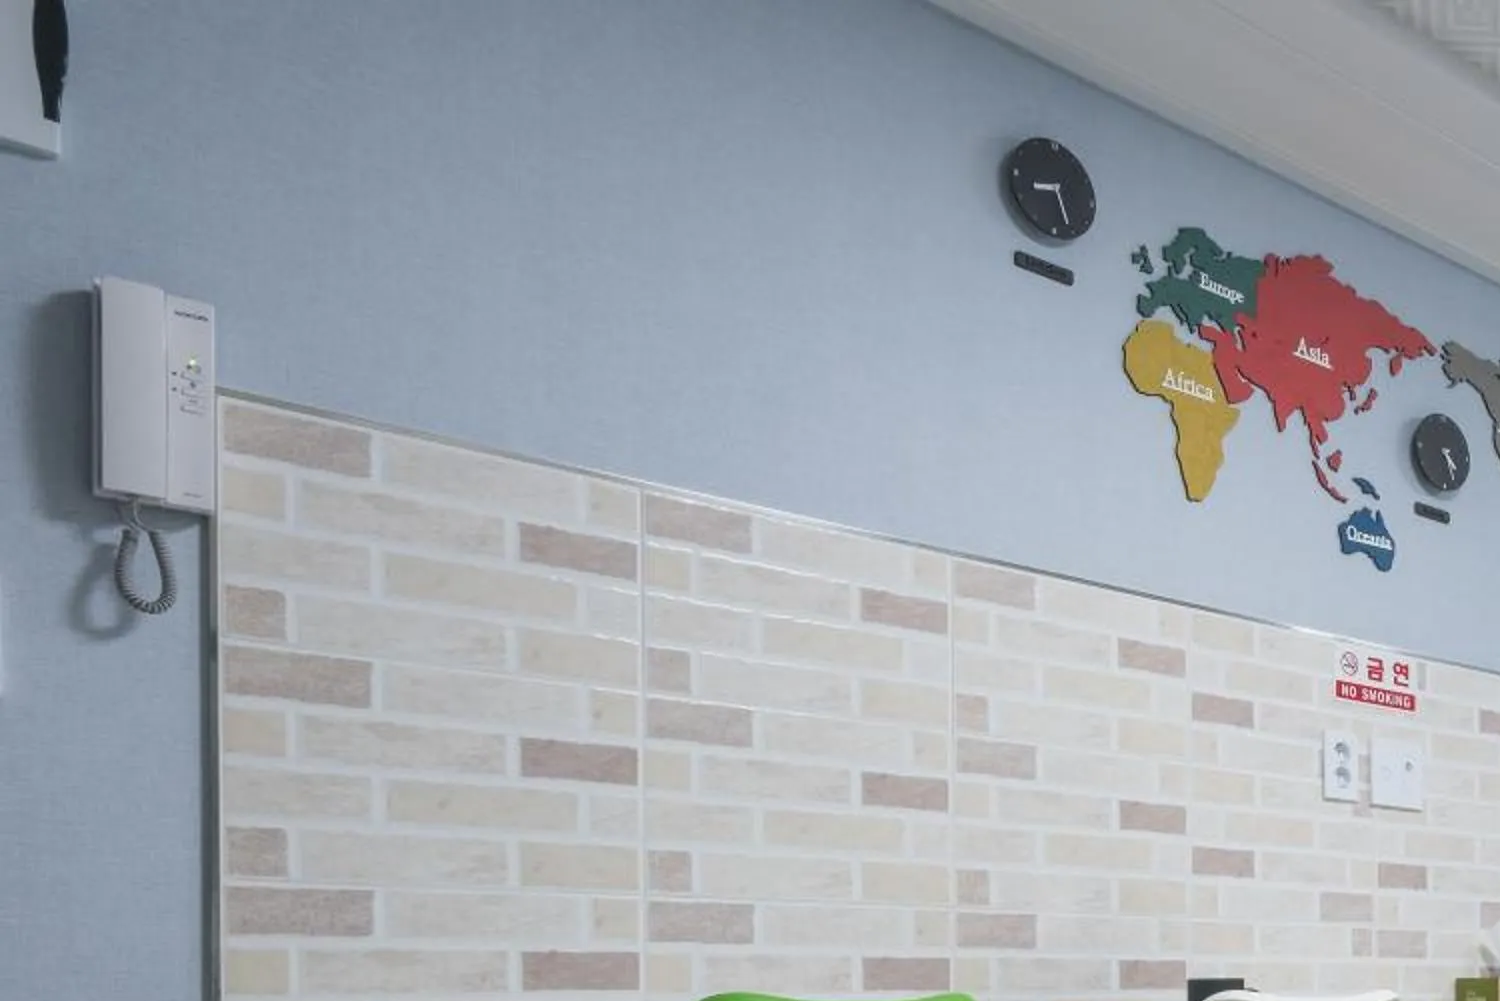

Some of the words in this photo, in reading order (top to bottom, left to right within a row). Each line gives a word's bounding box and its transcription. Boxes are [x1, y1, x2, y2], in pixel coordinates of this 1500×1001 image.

[1201, 273, 1244, 304] Europe
[1295, 337, 1333, 369] Asia
[1163, 368, 1215, 402] Africa
[1346, 525, 1392, 550] Oceania
[1341, 683, 1357, 698] NO
[1361, 687, 1412, 709] SMOKING
